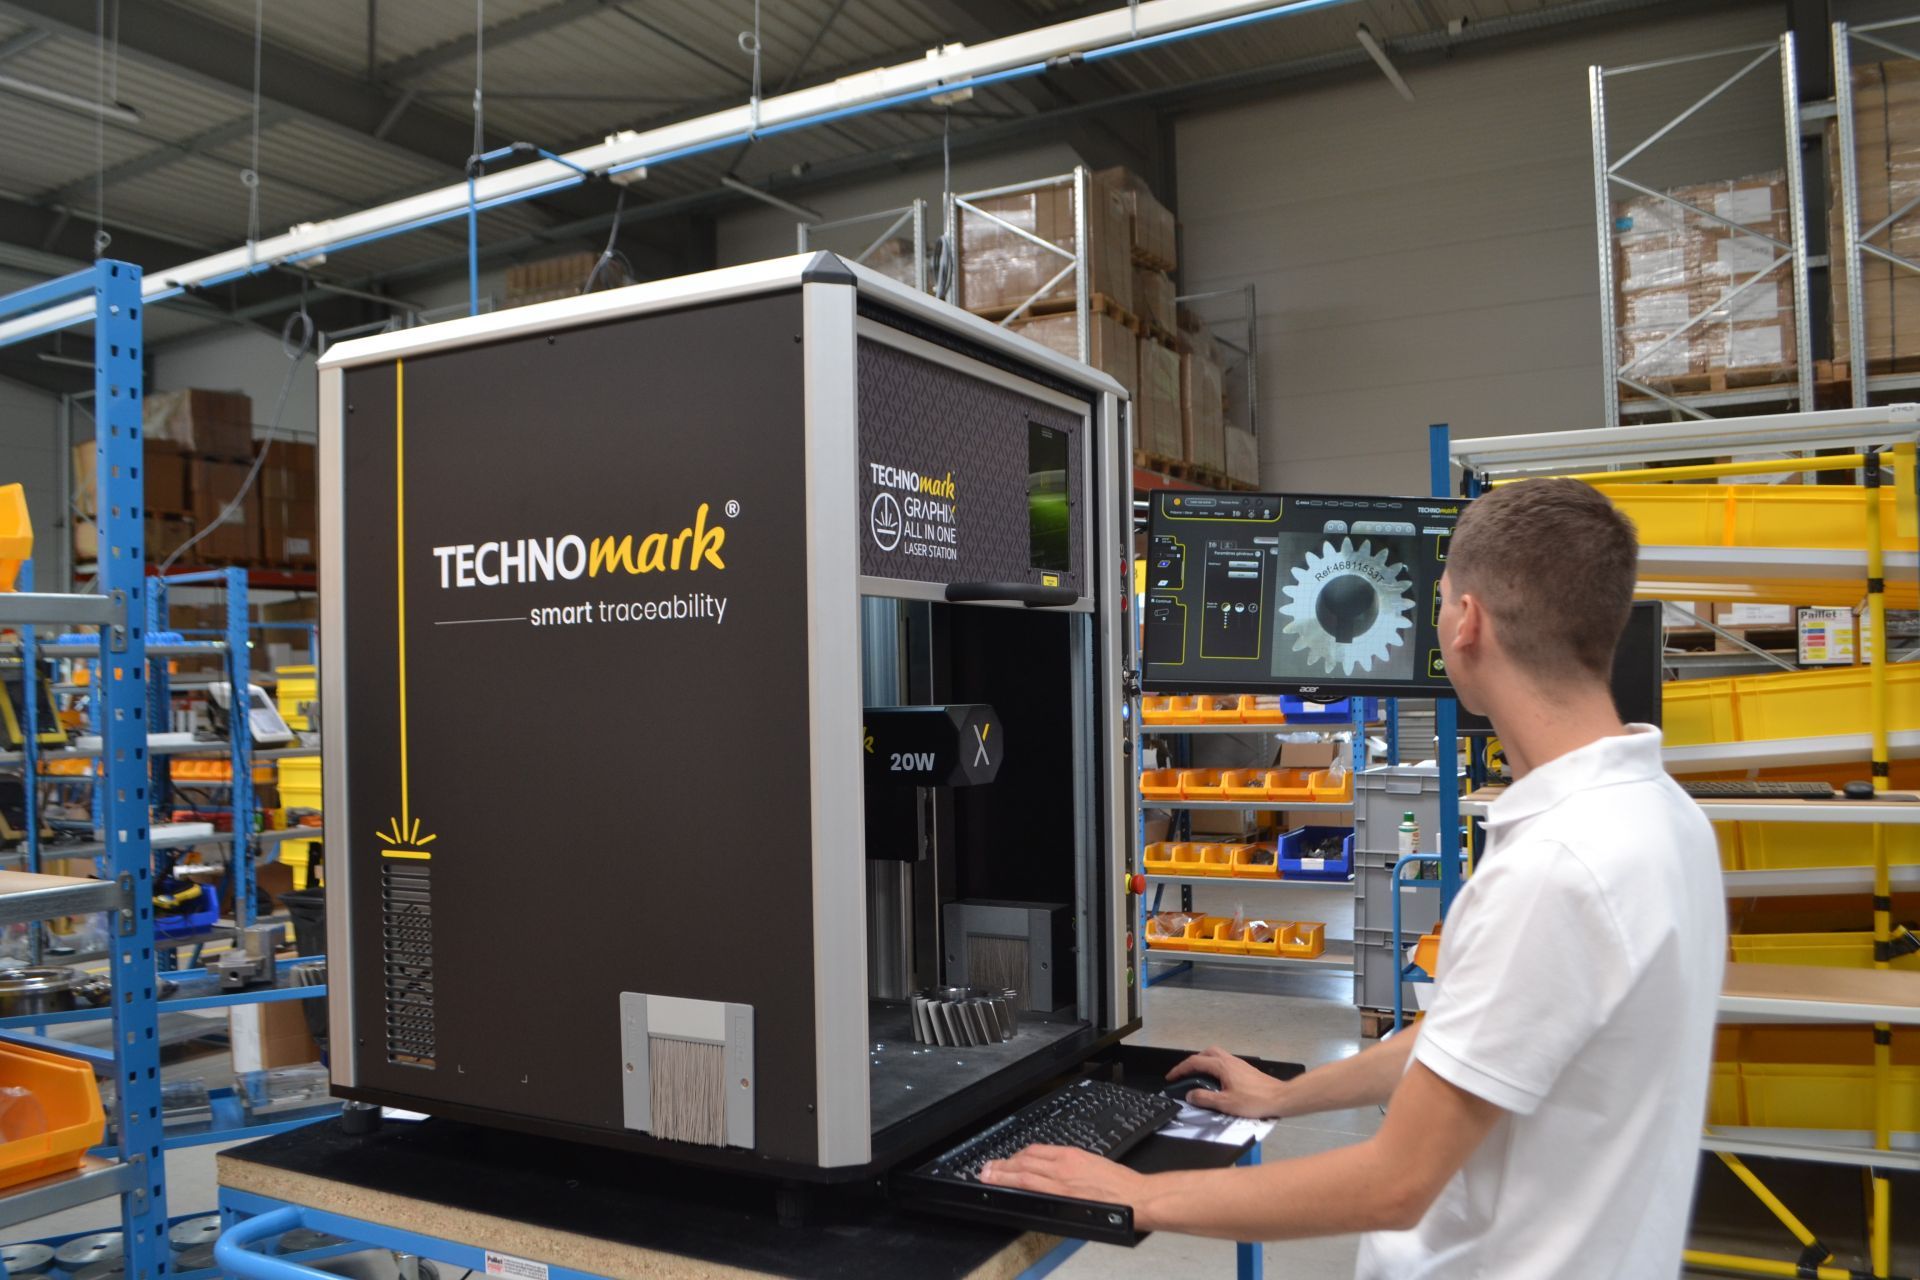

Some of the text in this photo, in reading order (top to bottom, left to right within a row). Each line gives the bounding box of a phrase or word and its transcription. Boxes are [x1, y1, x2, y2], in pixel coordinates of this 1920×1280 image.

[870, 462, 955, 500] TECHNOmark
[904, 496, 956, 525] GRAPHIX
[903, 520, 957, 544] ALL IN ONE
[904, 541, 957, 561] LASER STATION
[530, 592, 728, 626] smart traceability
[890, 752, 936, 771] 20W
